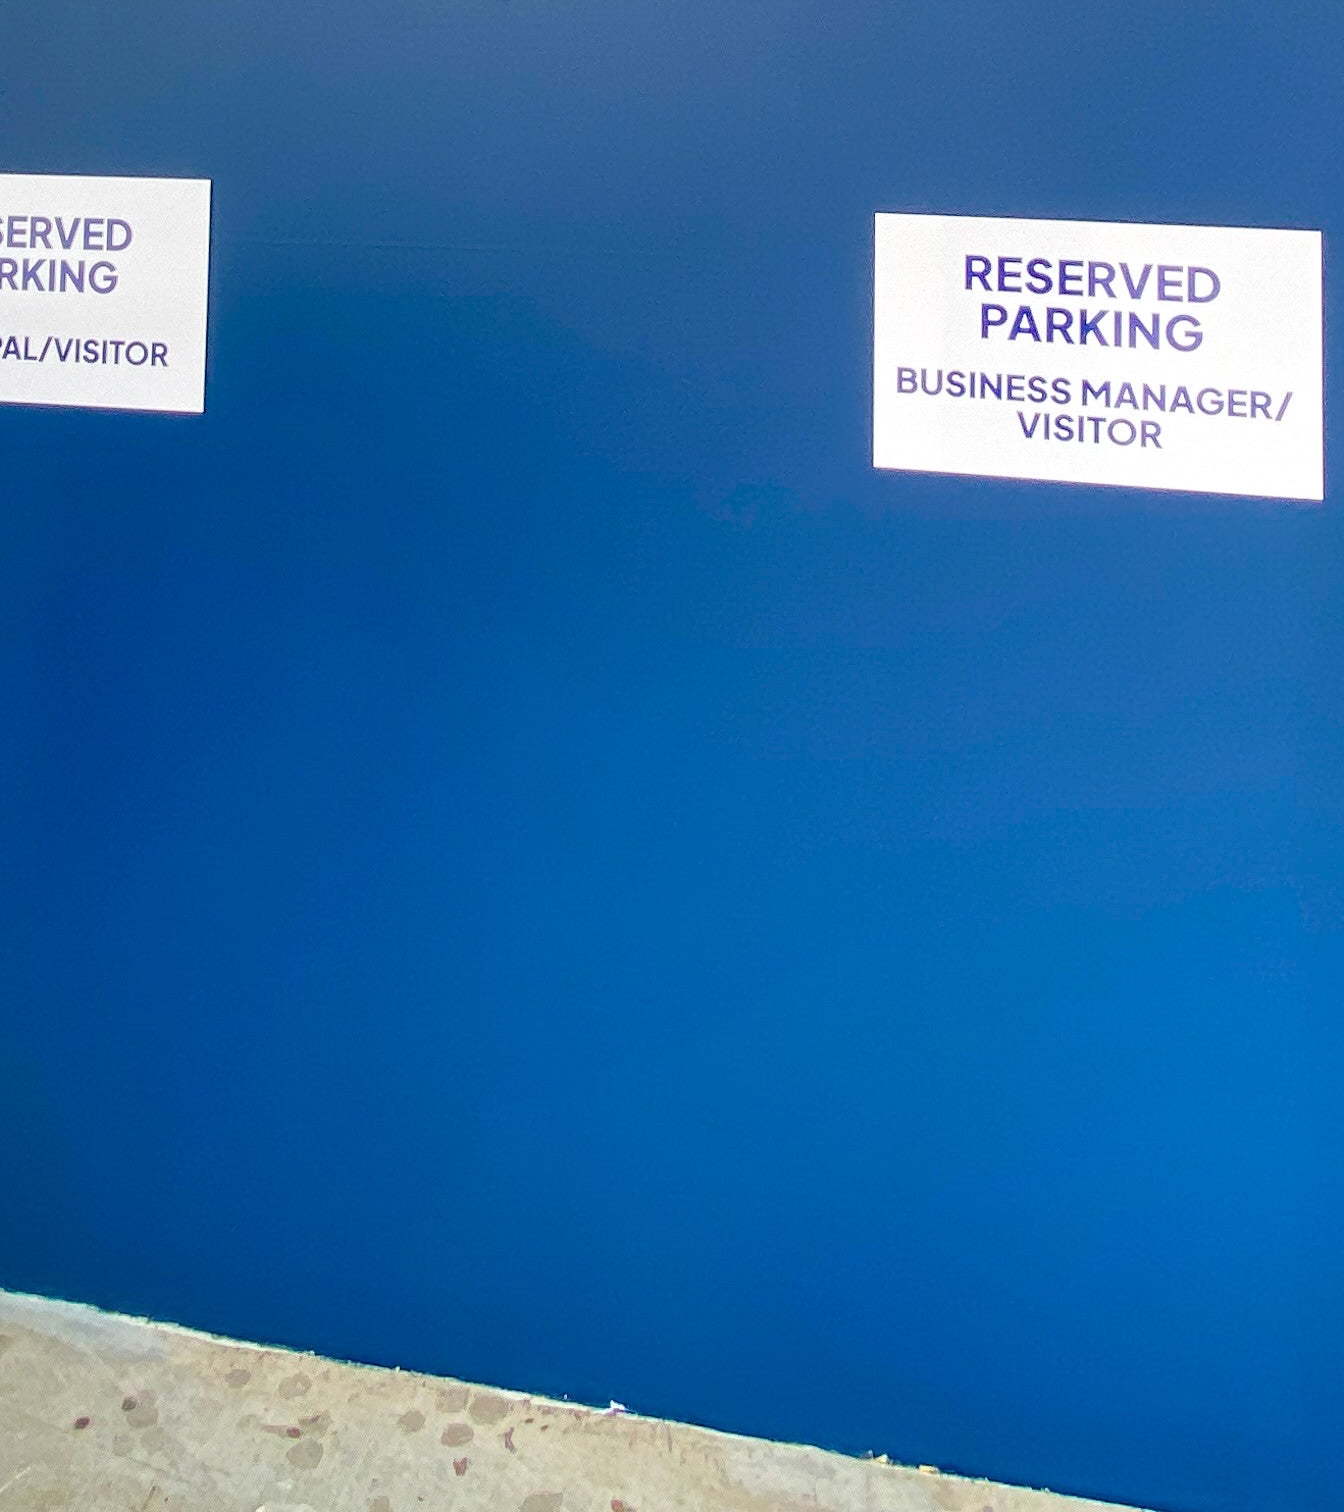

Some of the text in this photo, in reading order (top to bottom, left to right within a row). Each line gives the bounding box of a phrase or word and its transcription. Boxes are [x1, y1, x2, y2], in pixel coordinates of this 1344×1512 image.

[964, 254, 1221, 304] RESERVED
[981, 302, 1203, 352] PARKING
[896, 366, 1293, 422] BUSINESS MANAGER/
[1017, 411, 1163, 449] VISITOR
